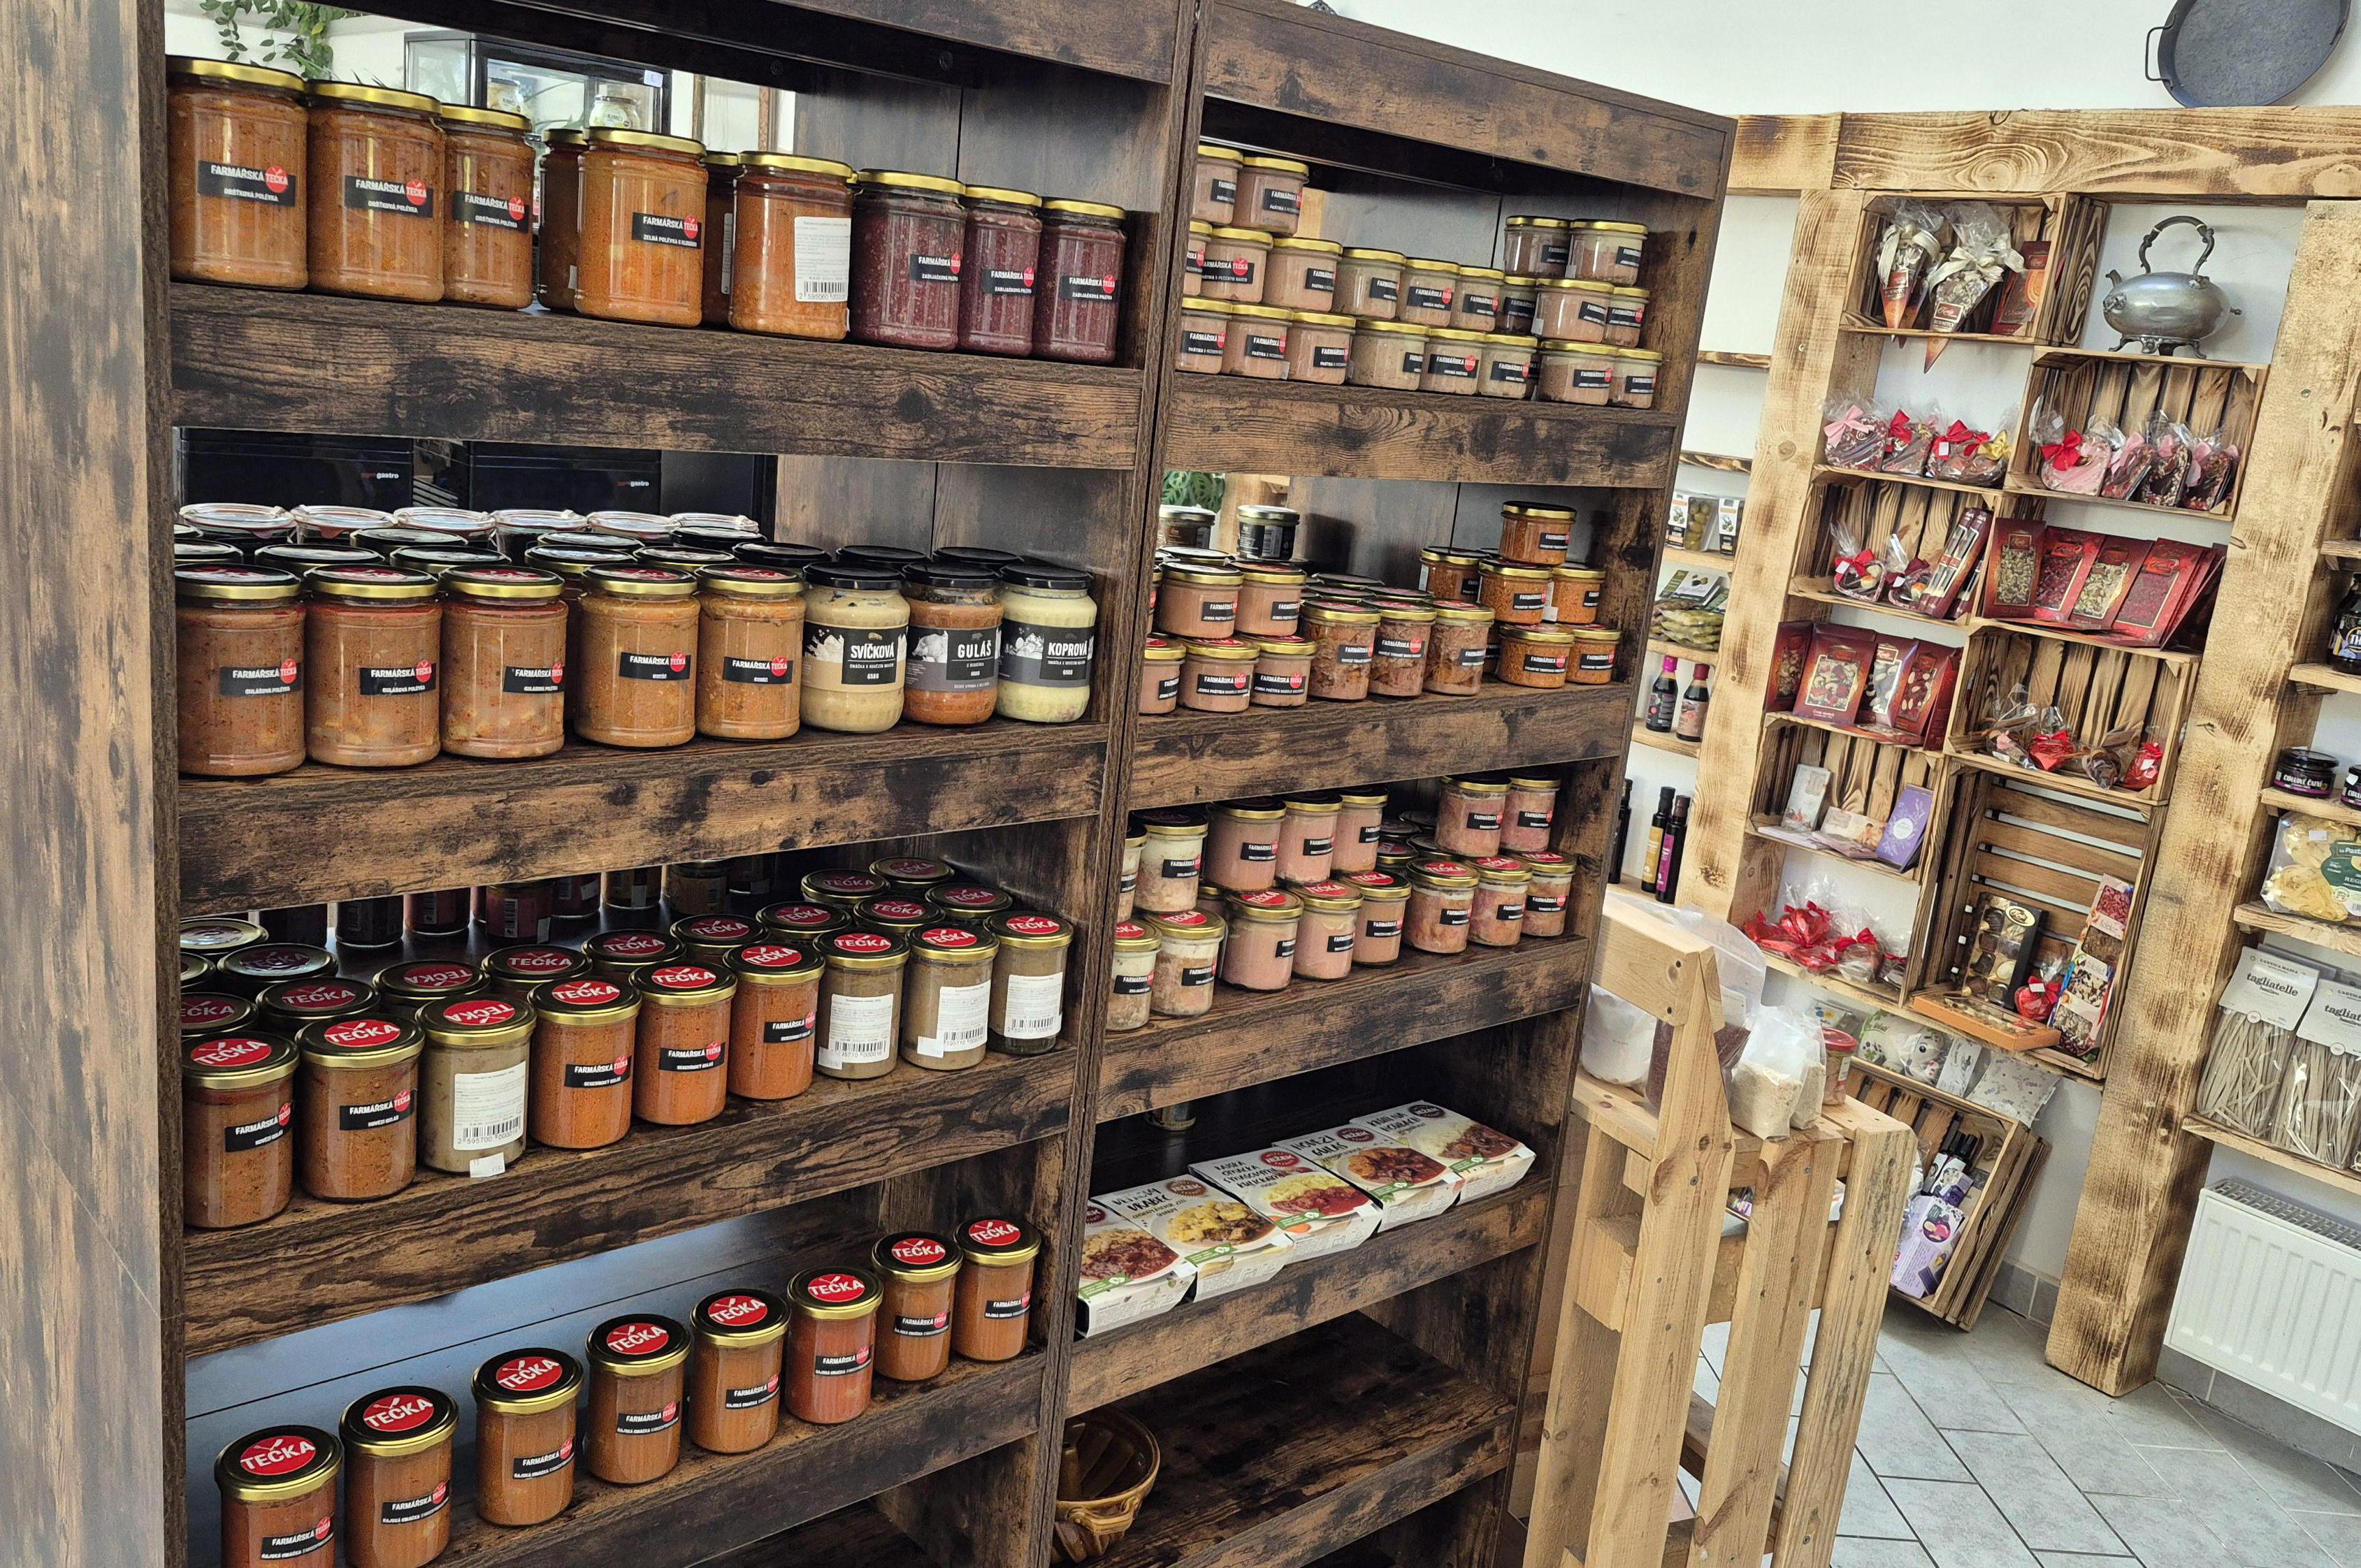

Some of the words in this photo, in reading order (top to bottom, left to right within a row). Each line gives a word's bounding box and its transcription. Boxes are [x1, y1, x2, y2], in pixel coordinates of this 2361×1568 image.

[851, 642, 894, 659] SVÍČKOVÁ
[958, 640, 991, 658] GULÁŠ
[1048, 640, 1088, 656] KOPROVÁ
[2246, 973, 2298, 996] tagliatelle
